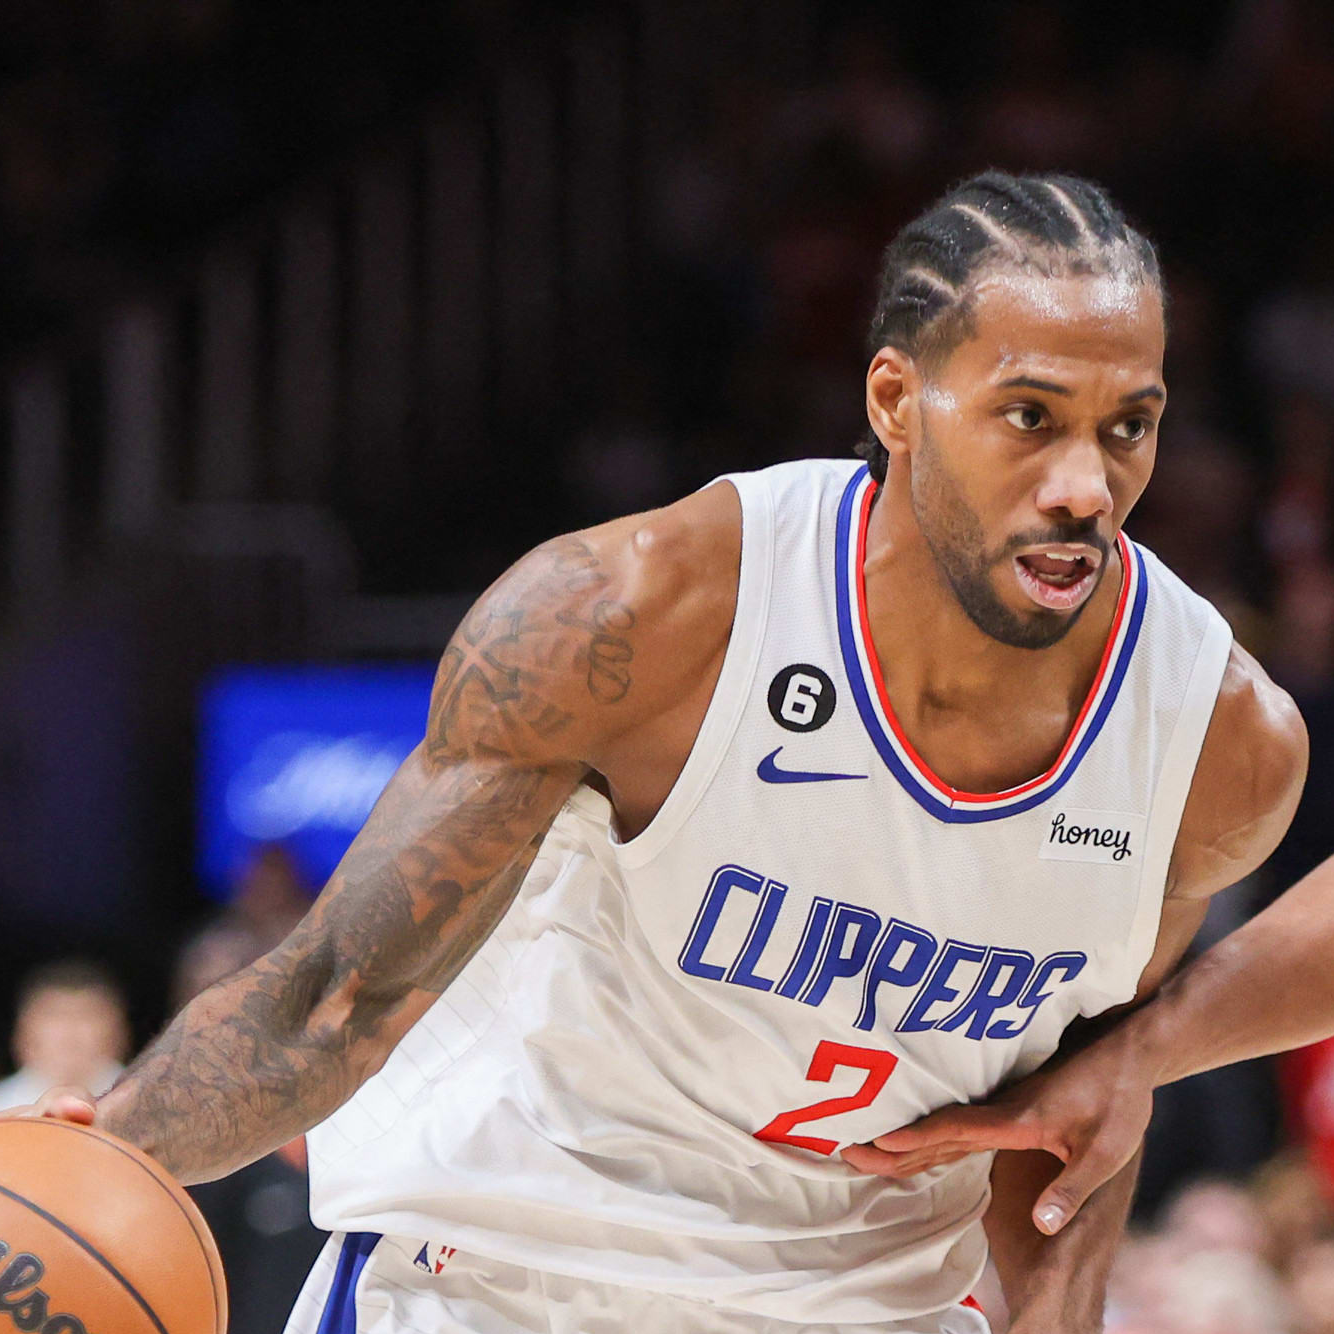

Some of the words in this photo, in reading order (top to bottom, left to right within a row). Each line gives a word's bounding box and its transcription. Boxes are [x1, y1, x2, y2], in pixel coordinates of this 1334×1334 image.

[778, 672, 823, 726] 6
[1049, 812, 1132, 861] honey
[677, 863, 1088, 1042] CLIPPERS
[753, 1040, 899, 1156] 2
